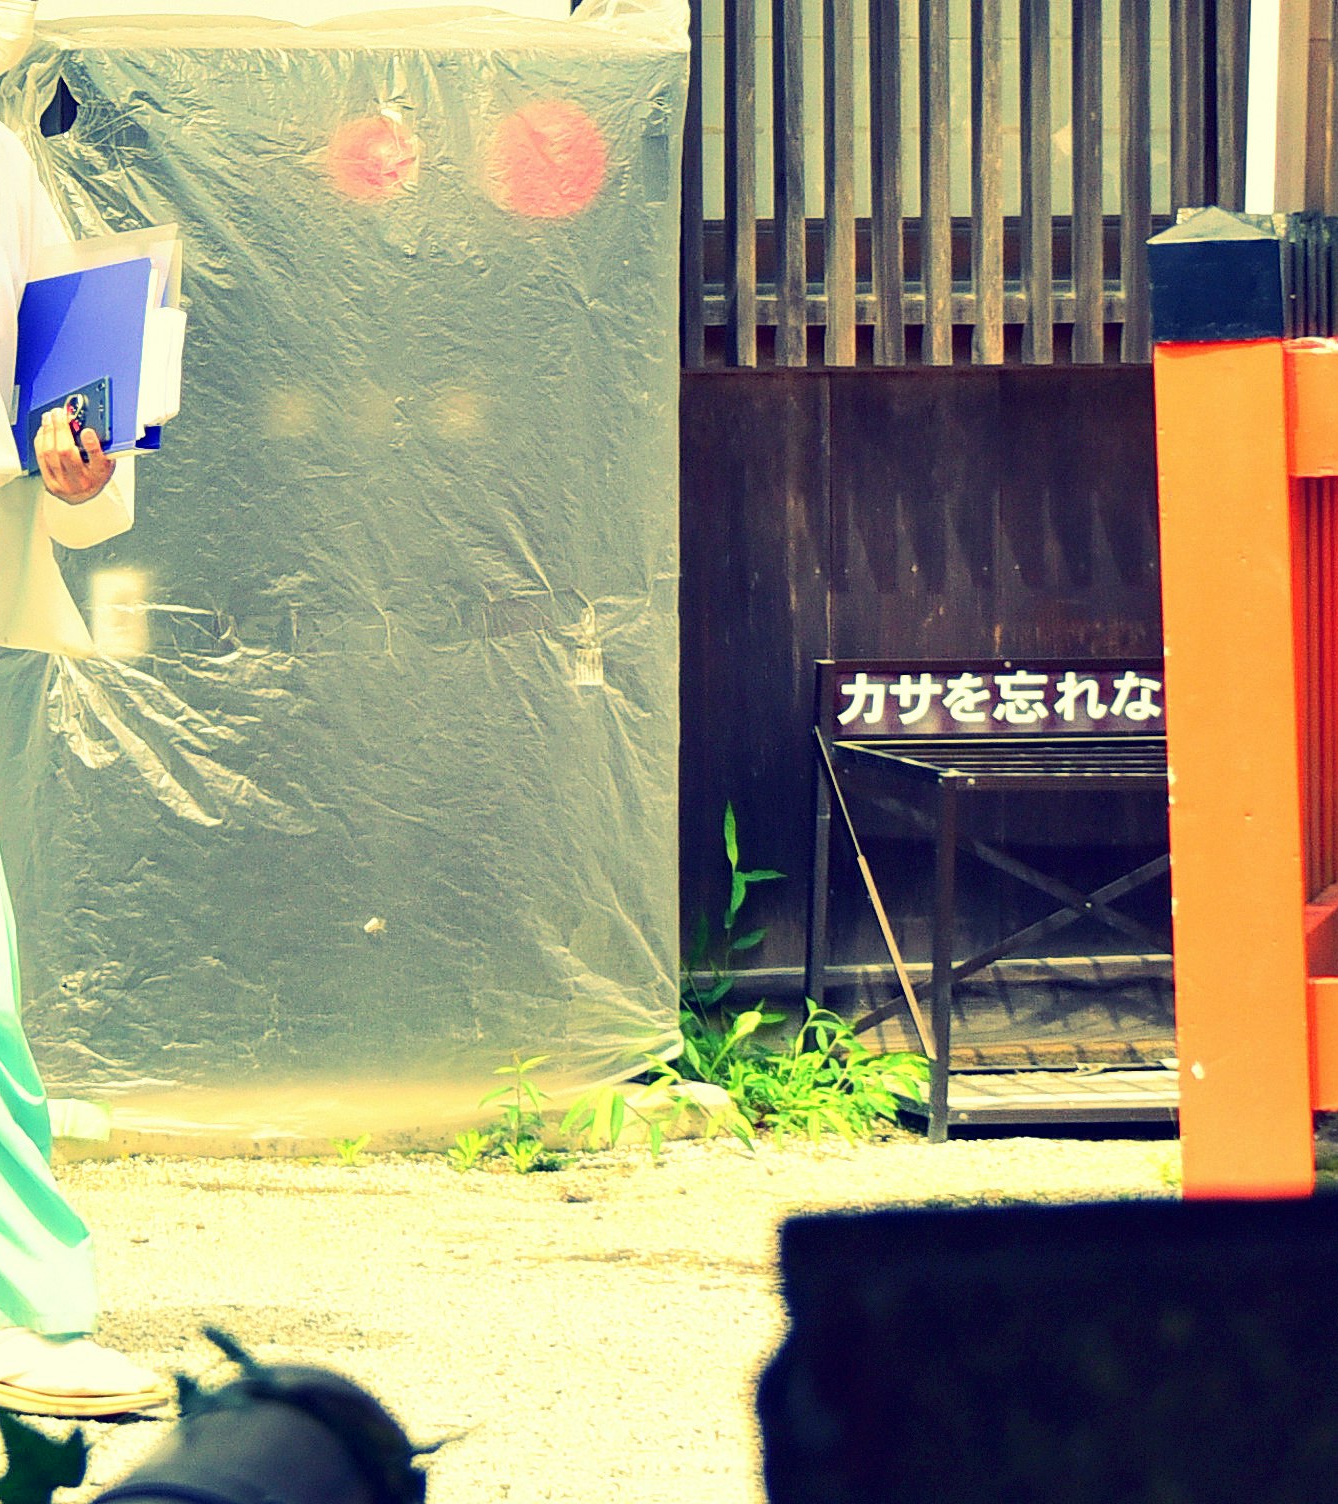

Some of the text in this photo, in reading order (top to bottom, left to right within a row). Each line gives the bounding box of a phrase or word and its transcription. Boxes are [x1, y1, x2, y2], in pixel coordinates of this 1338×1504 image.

[836, 670, 1163, 725] カサを忘れな
